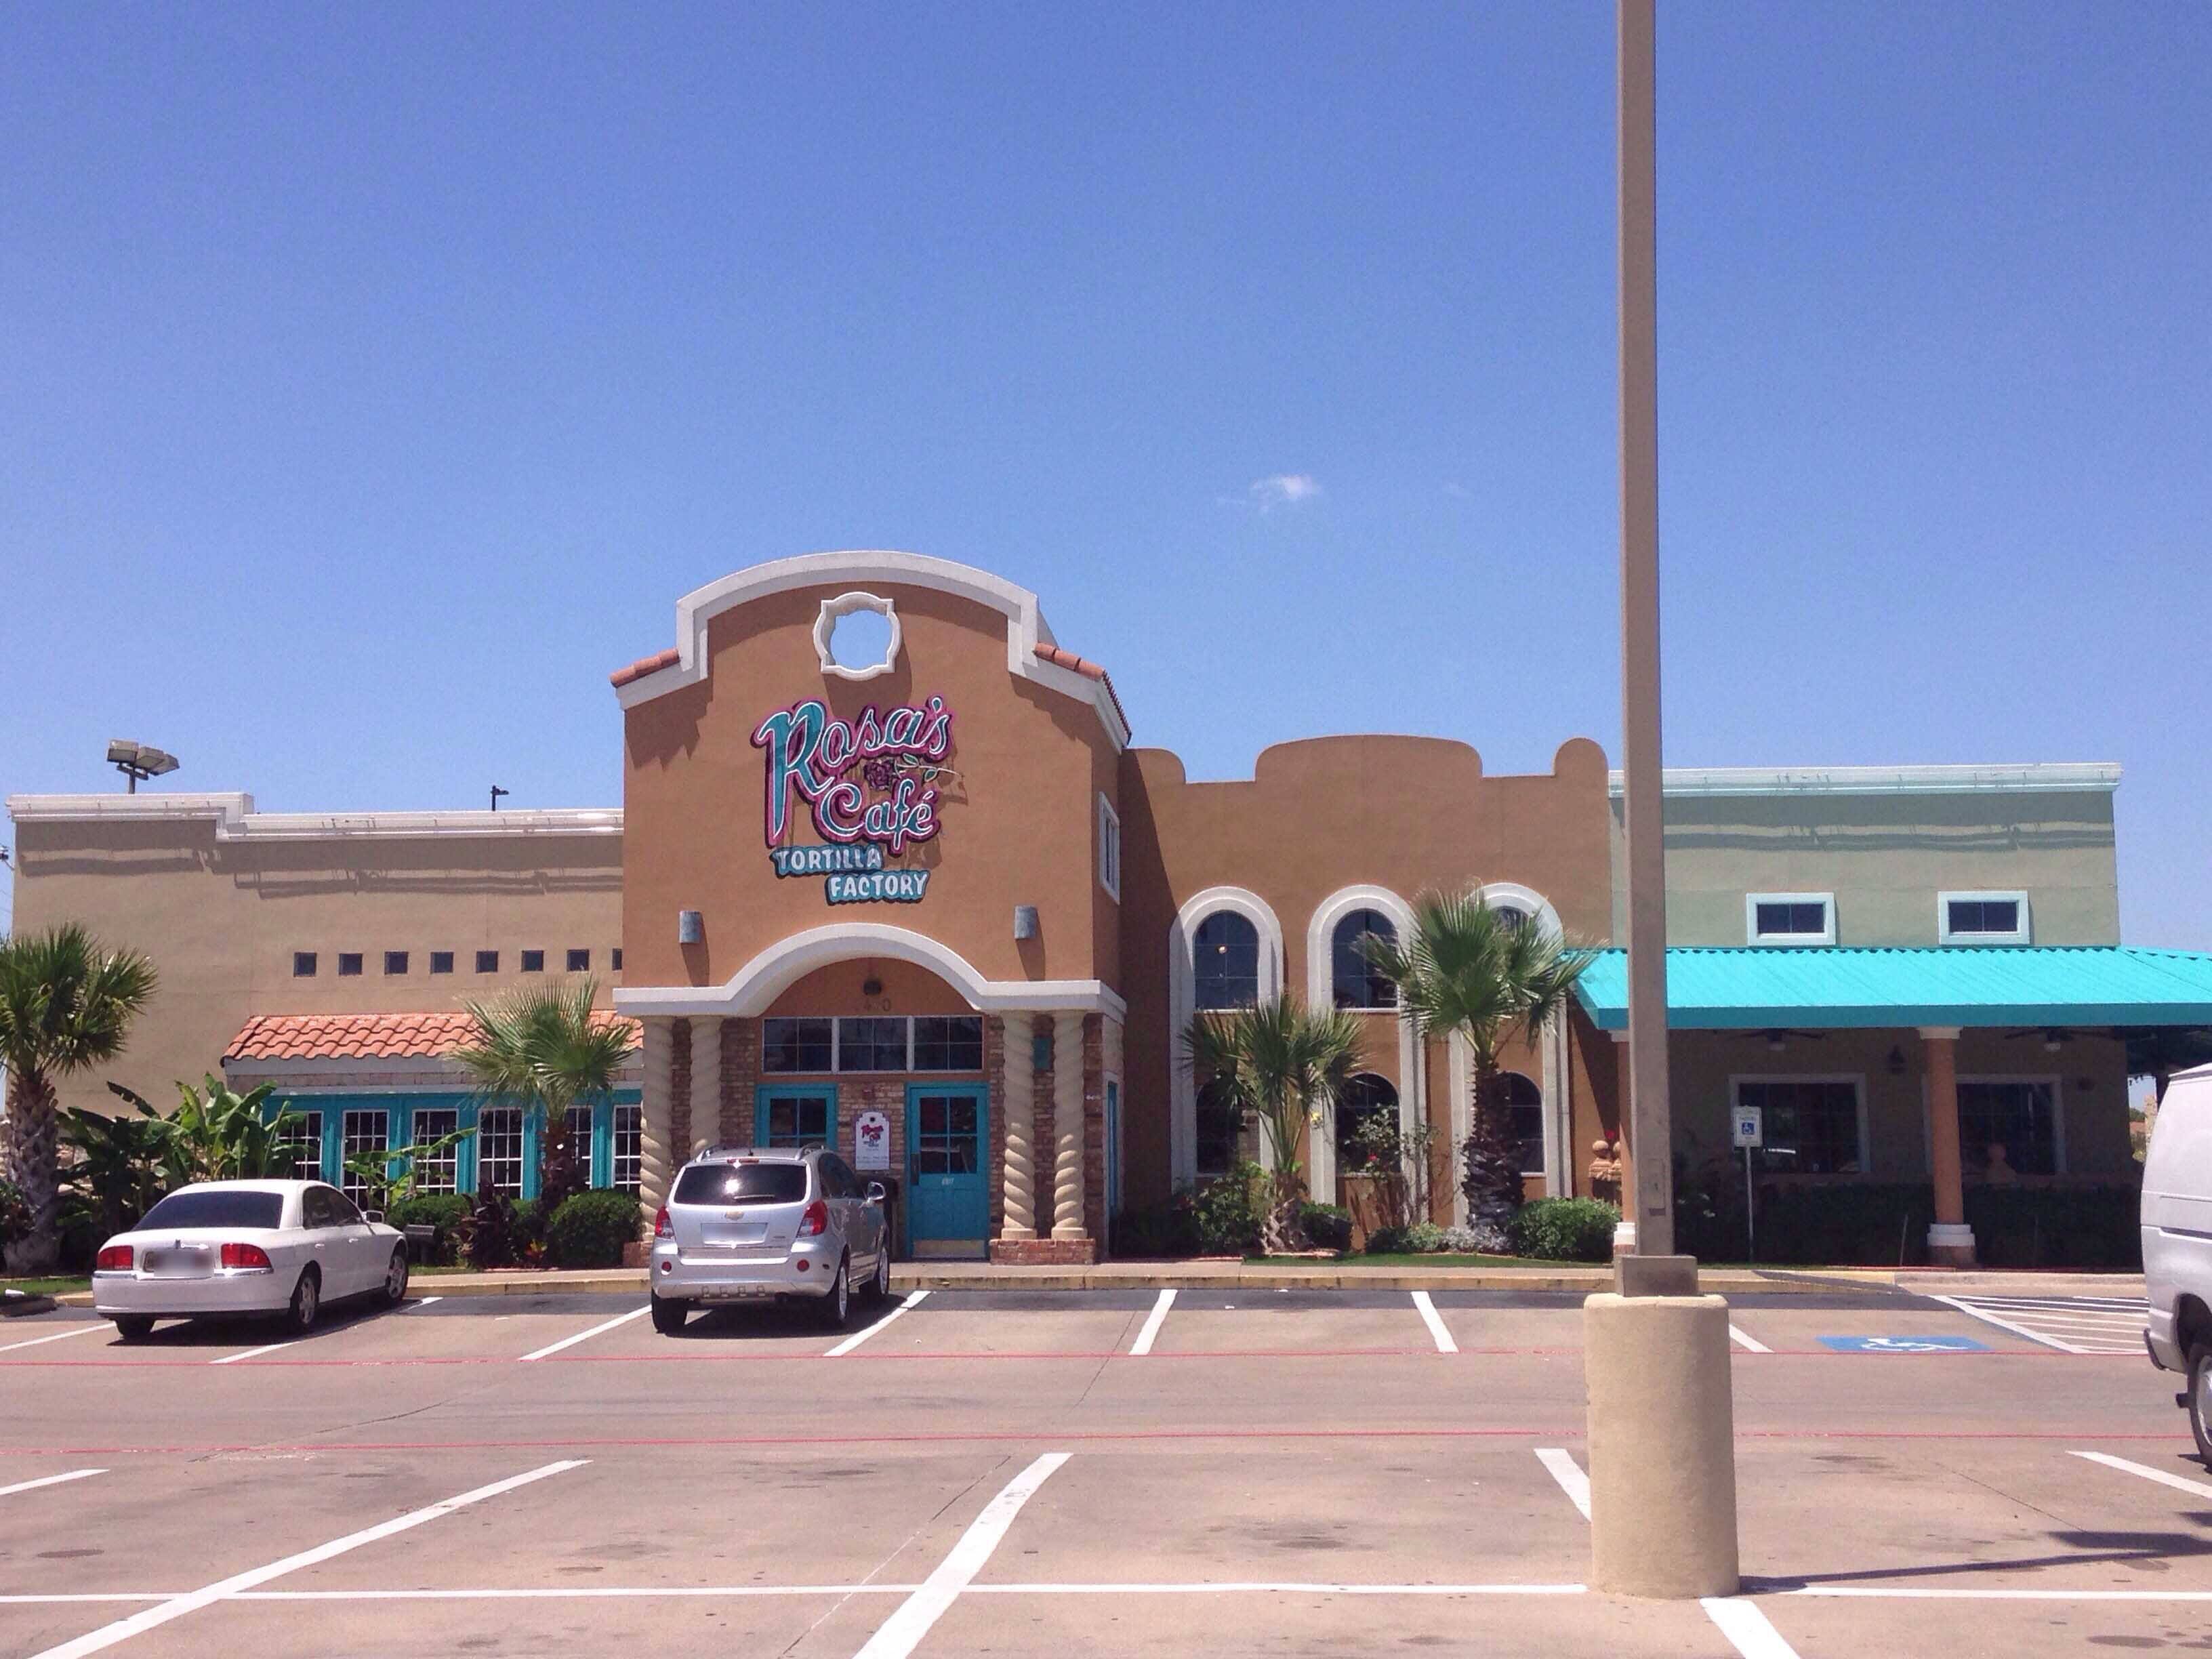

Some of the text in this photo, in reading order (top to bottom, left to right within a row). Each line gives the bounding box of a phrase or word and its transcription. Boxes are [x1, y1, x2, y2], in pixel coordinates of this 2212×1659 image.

[754, 696, 952, 842] Rosa's
[817, 778, 935, 851] Café
[775, 847, 881, 871] TORTILLA
[829, 872, 928, 897] FACTORY
